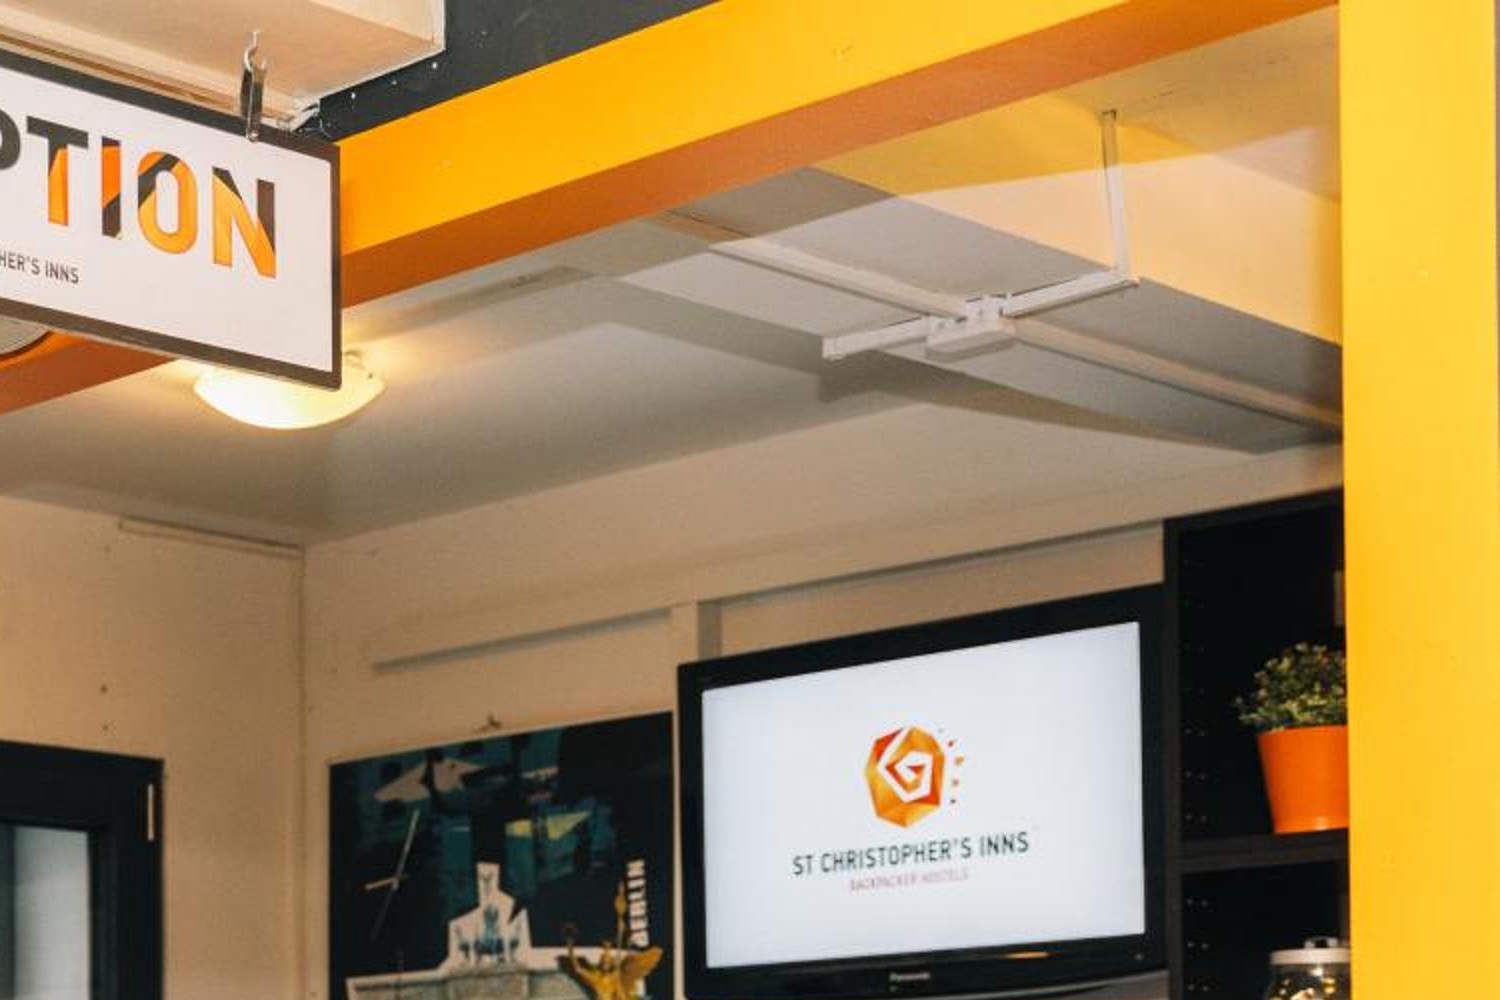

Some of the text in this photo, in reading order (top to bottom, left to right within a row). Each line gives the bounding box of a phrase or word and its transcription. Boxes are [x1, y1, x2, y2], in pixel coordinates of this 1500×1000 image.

[45, 259, 80, 284] INNS
[792, 831, 1030, 876] ST CHRISTOPHER'S INNS
[628, 860, 649, 947] BERLIN
